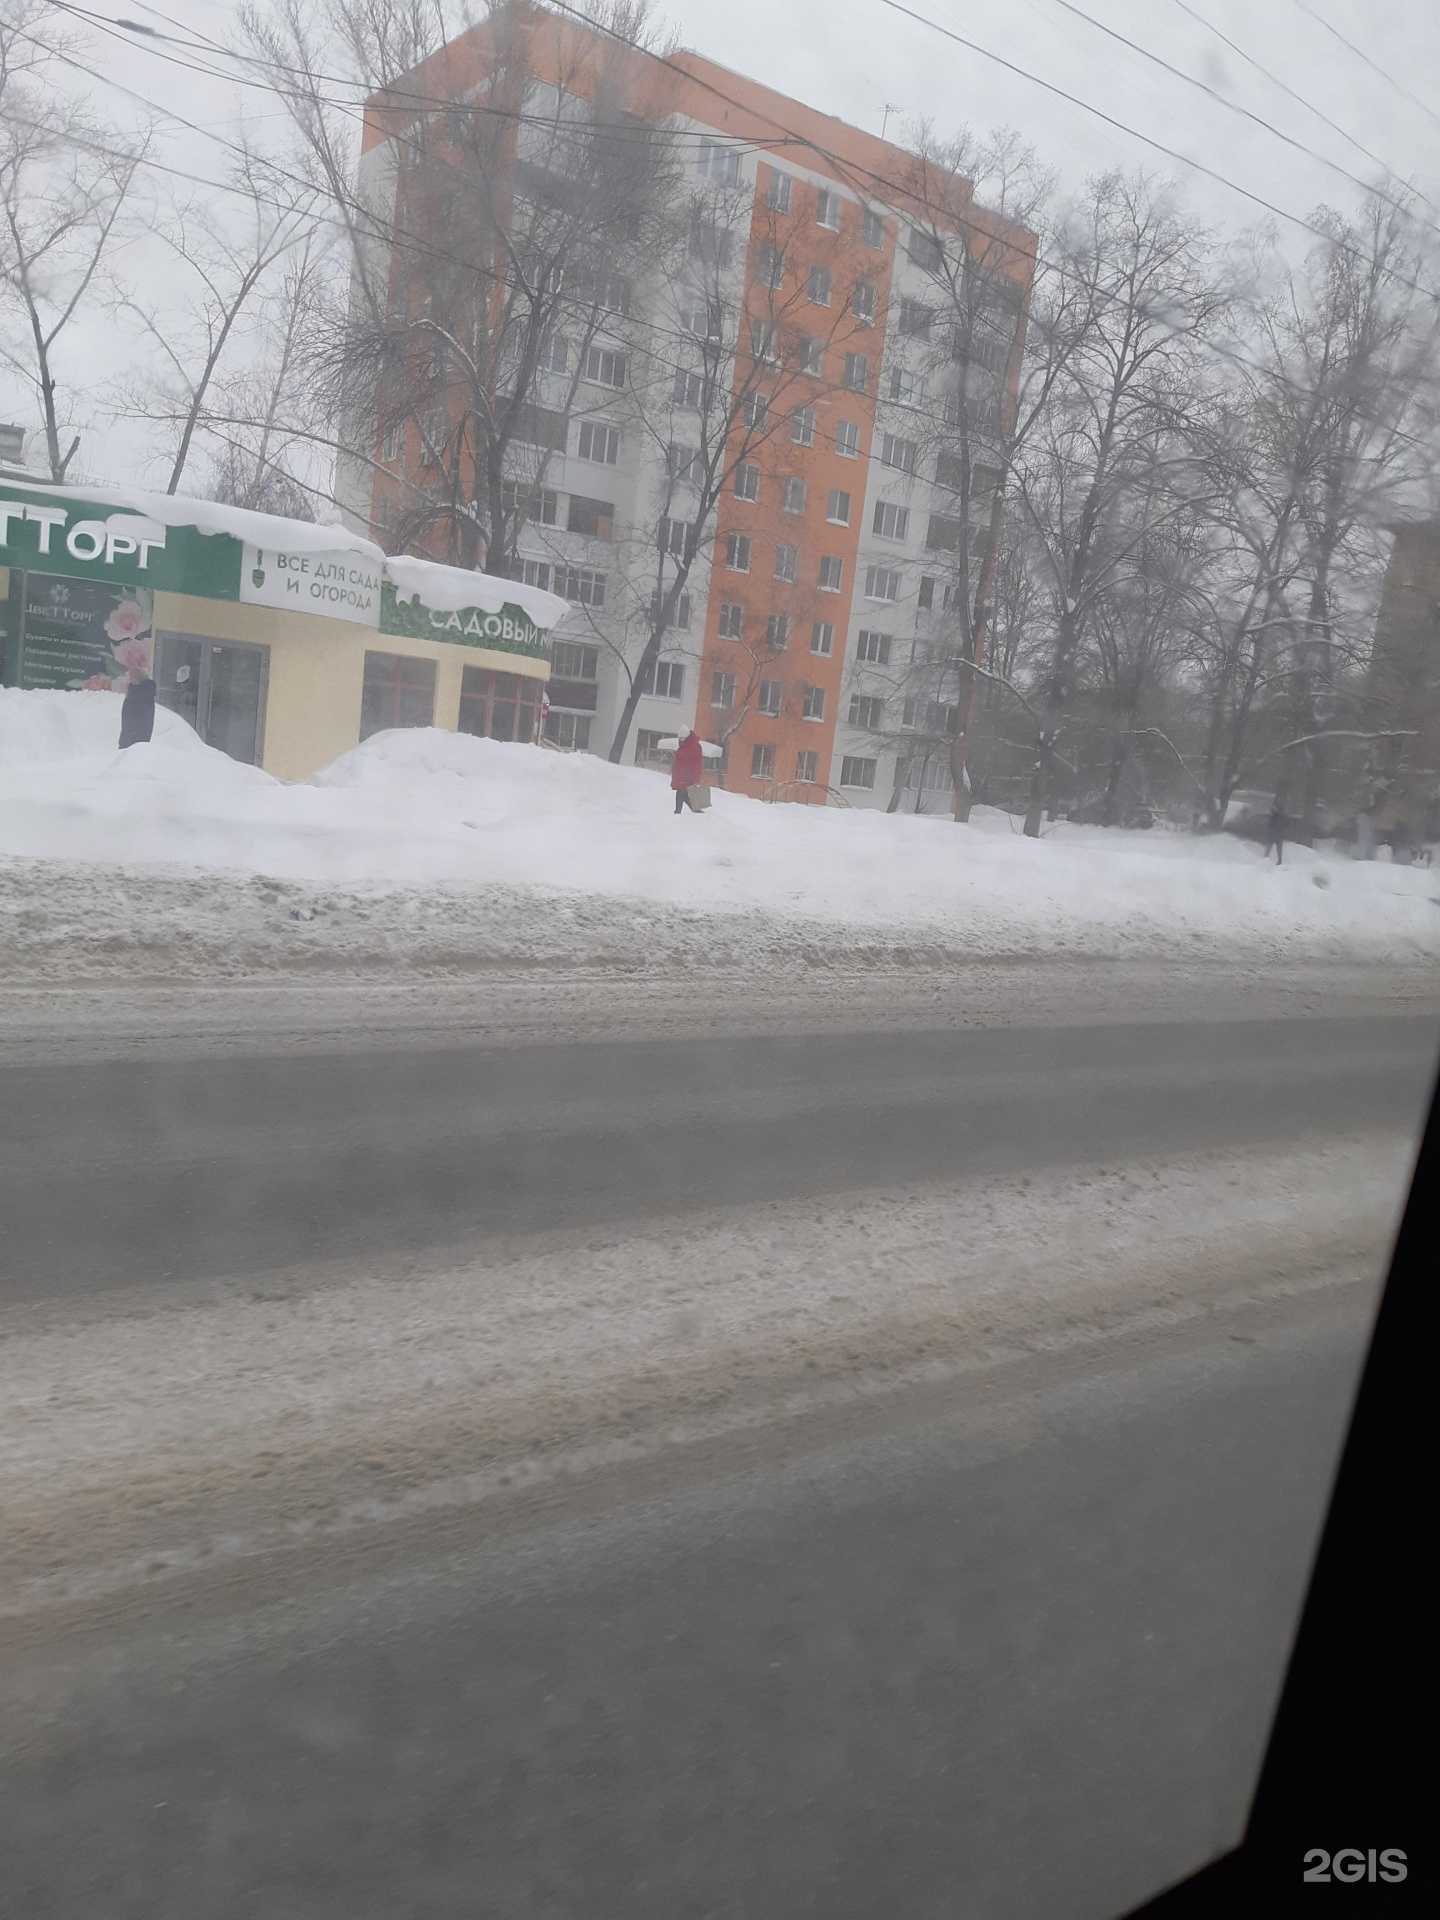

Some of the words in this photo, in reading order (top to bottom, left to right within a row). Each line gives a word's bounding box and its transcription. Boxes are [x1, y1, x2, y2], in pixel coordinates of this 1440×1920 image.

[277, 553, 309, 573] ВСЕ
[314, 562, 345, 582] ДЛЯ
[349, 570, 379, 591] САДА
[286, 577, 299, 593] И
[310, 582, 371, 609] ОГОРОДА
